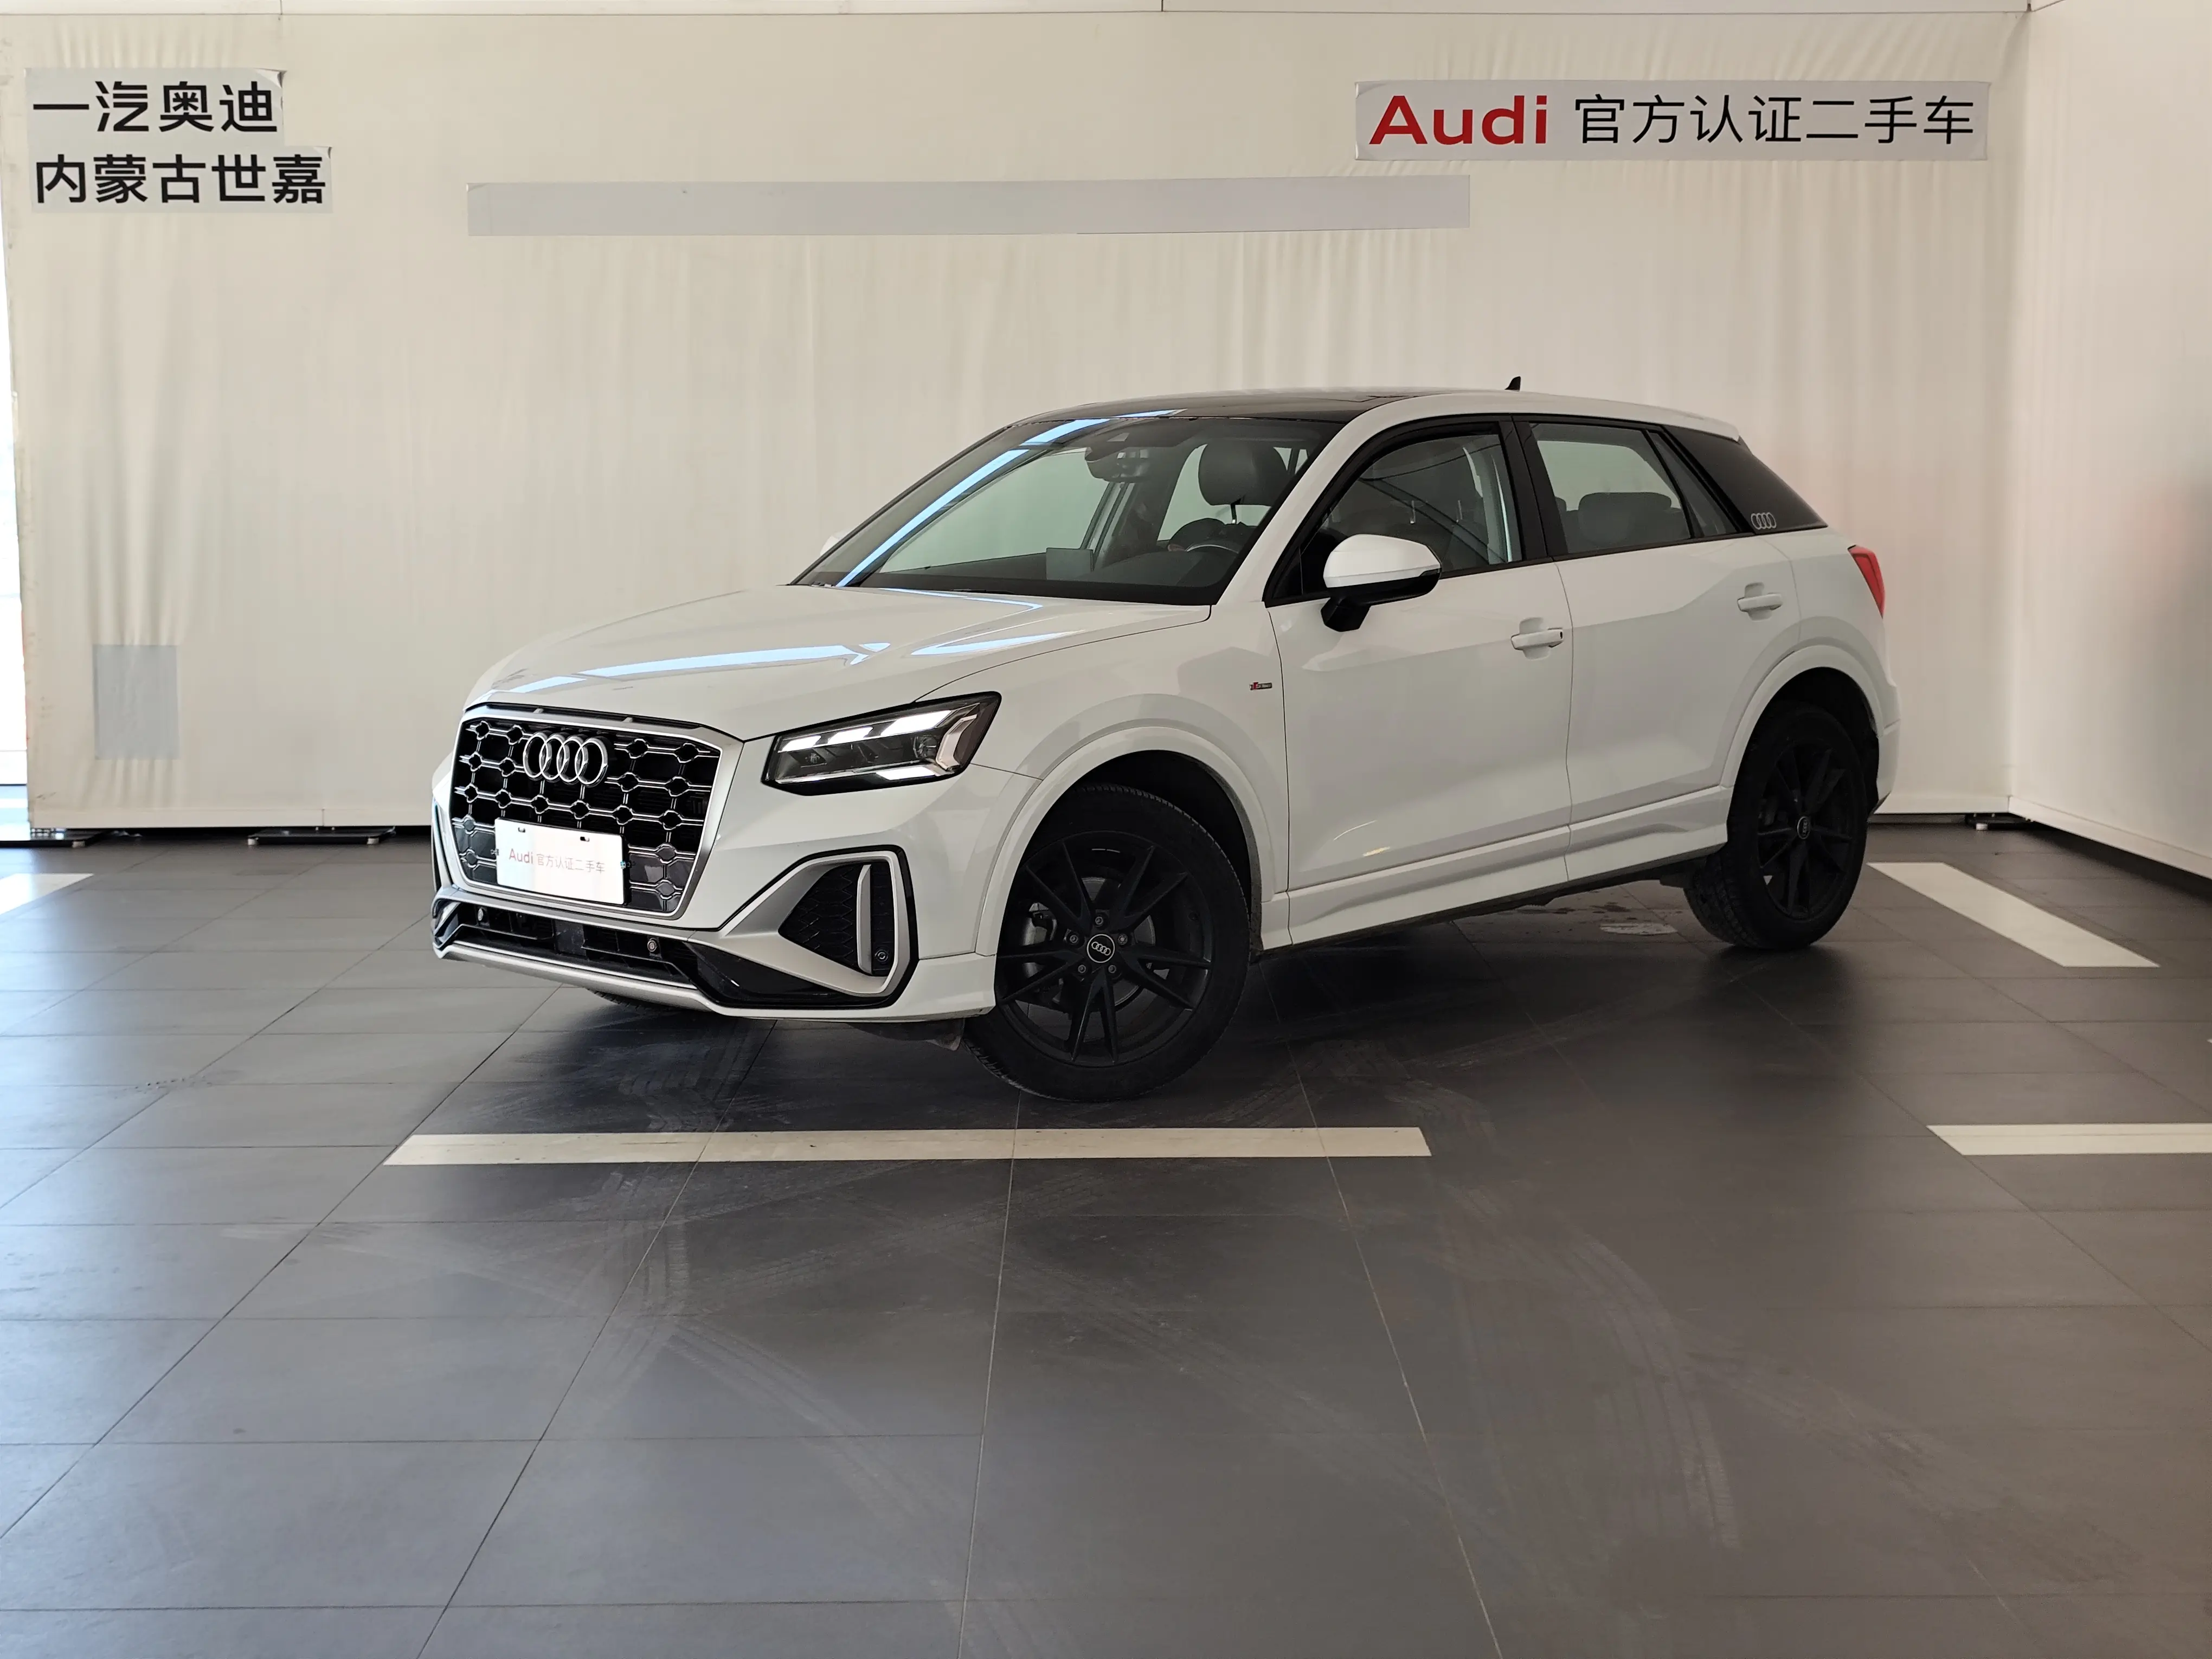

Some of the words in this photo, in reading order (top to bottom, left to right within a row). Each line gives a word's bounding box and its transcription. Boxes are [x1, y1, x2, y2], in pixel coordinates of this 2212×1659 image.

[33, 81, 278, 132] 一汽奥迪
[1369, 95, 1547, 145] Audi
[1575, 93, 1974, 145] 官方认证二手车
[36, 153, 326, 204] 内蒙古世嘉
[509, 848, 533, 864] Audi
[536, 853, 606, 874] 官方认证二手车
